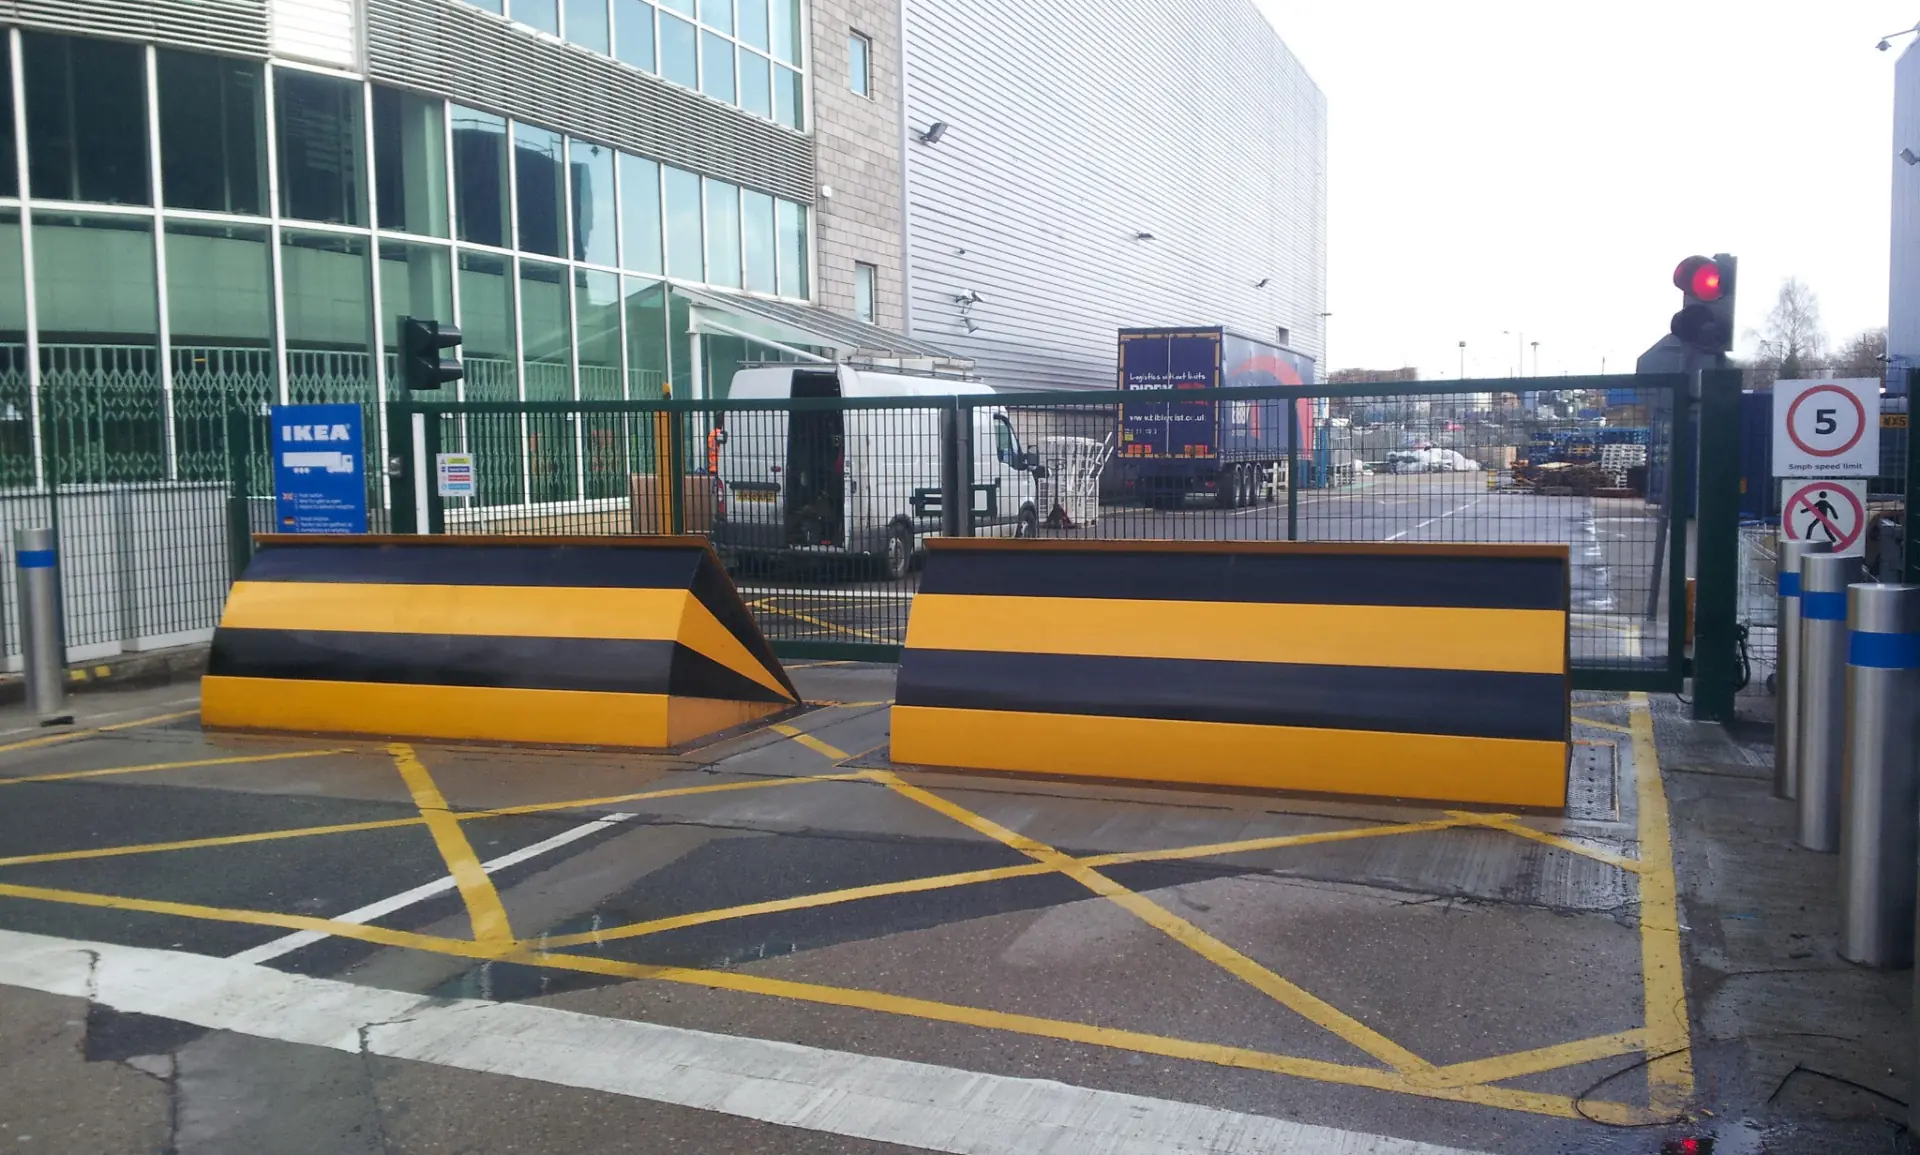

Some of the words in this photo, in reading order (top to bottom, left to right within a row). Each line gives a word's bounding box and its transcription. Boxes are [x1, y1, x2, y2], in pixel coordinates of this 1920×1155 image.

[1129, 373, 1161, 383] Logistics
[1815, 409, 1837, 435] 5
[282, 424, 350, 441] IKEA
[1789, 463, 1812, 471] 5mph
[1815, 463, 1841, 471] speed
[1843, 462, 1863, 470] limit
